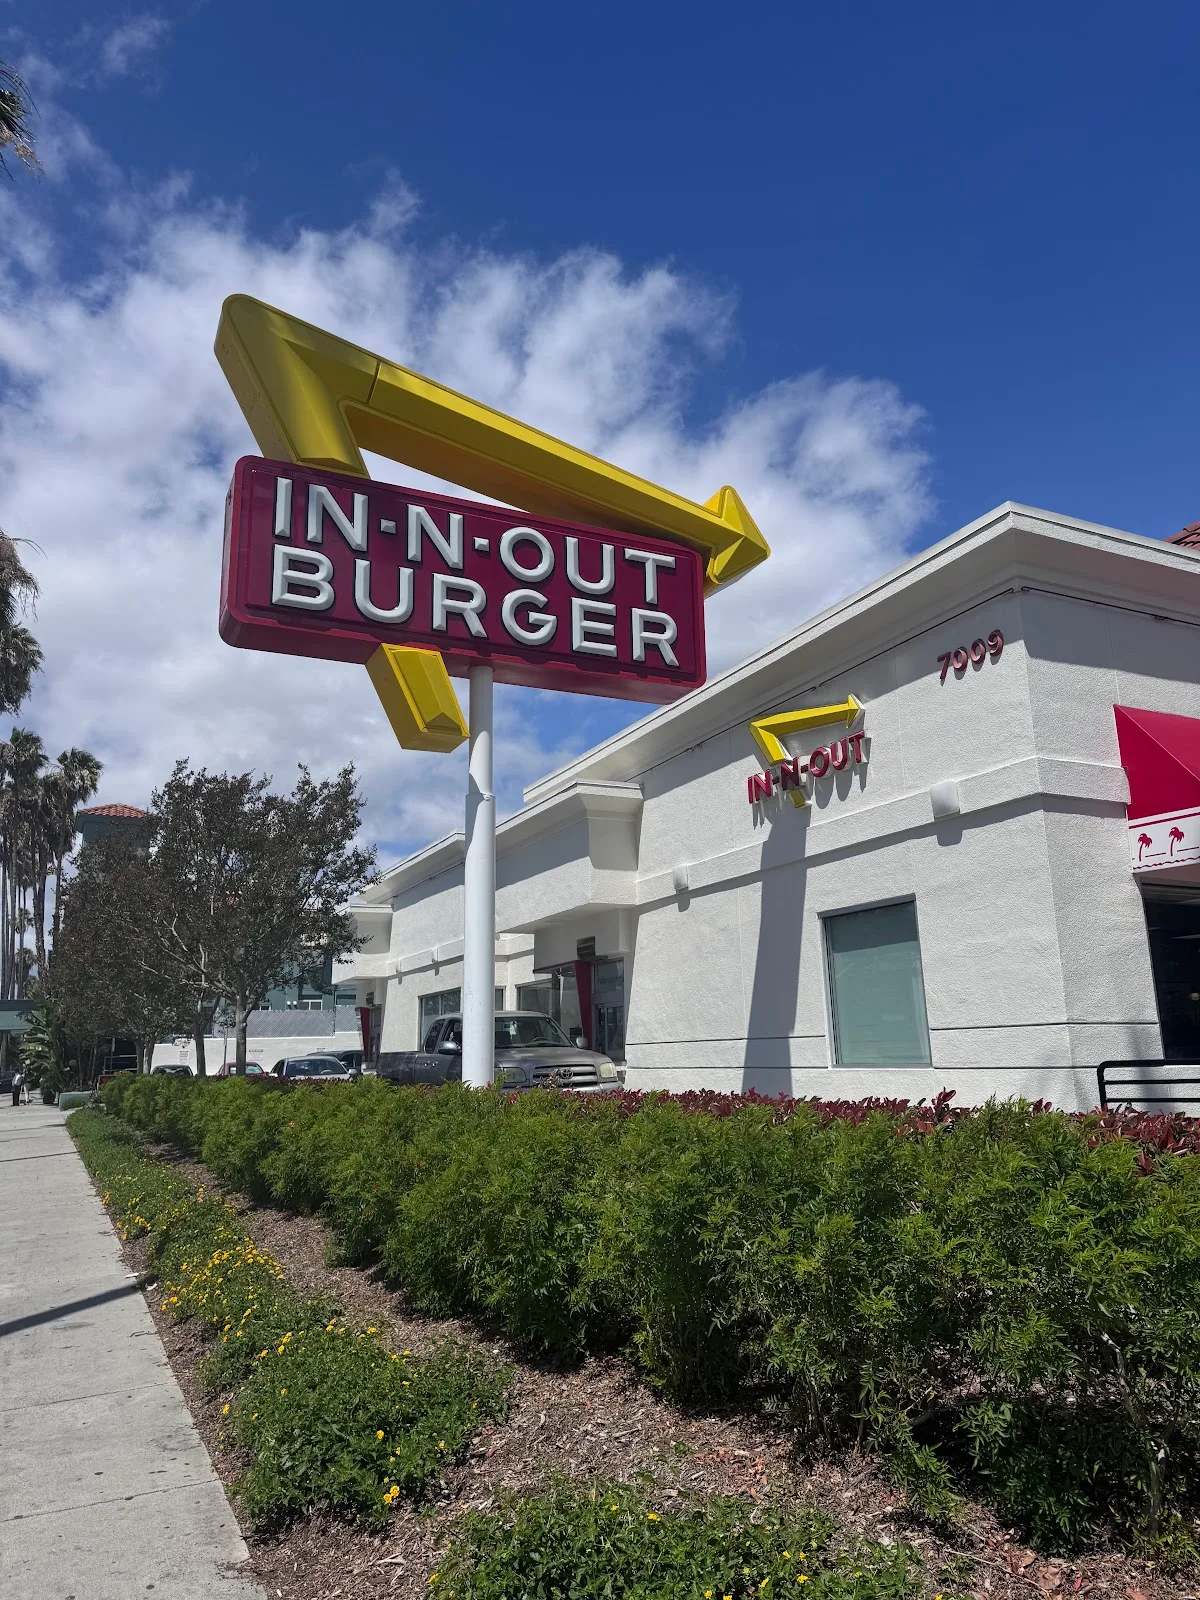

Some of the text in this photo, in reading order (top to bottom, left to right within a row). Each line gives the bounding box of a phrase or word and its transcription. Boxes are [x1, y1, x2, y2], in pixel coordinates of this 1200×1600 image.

[273, 477, 676, 604] IN-N-OUT
[272, 545, 679, 667] BURGER
[937, 629, 1004, 680] 7009
[747, 731, 865, 804] IN-N-OUT
